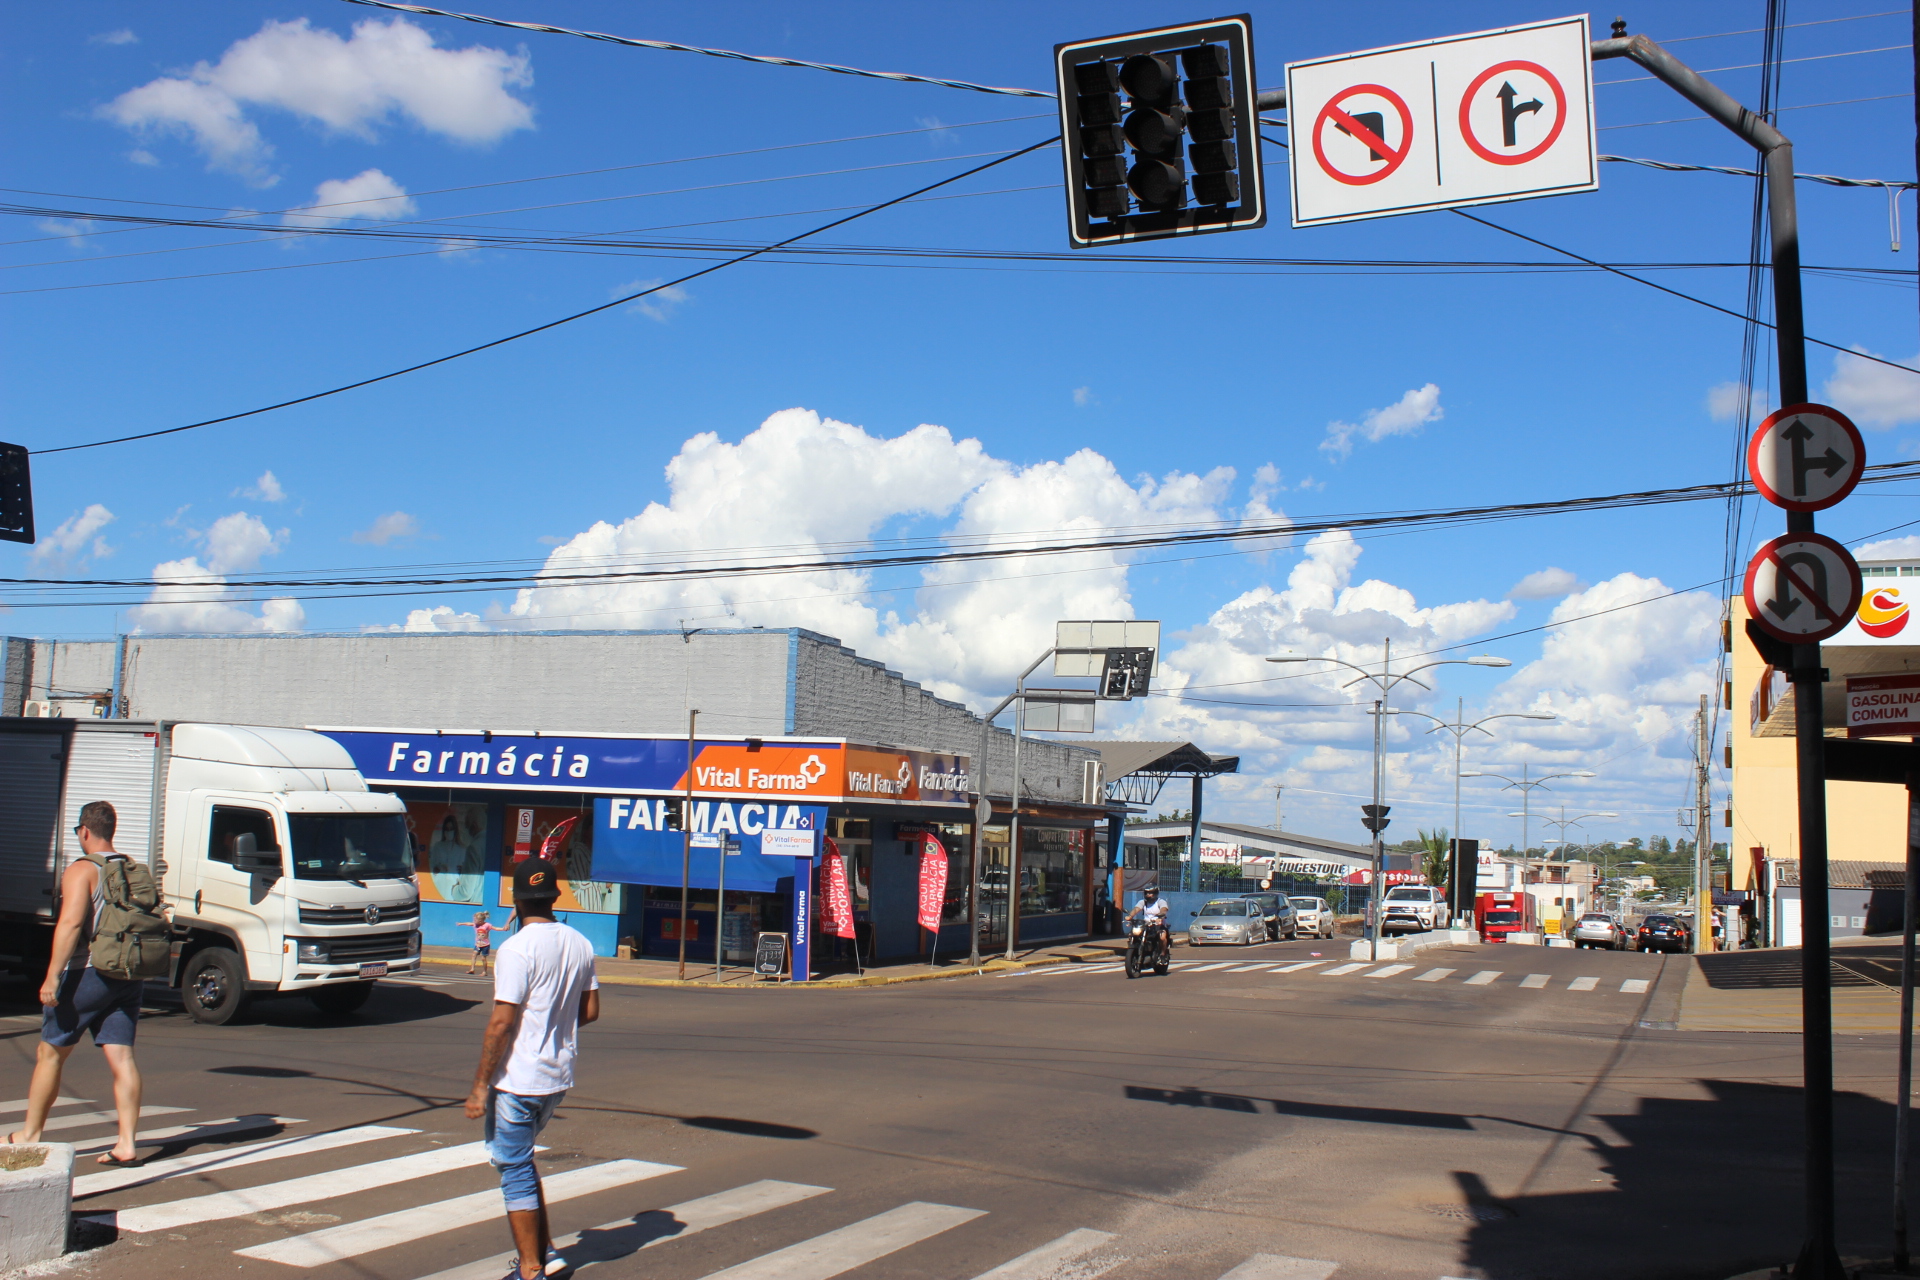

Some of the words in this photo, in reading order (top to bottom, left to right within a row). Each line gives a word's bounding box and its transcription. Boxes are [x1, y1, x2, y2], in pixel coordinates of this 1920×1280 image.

[1851, 692, 1920, 708] GASOLINA
[1852, 707, 1908, 722] COMUM
[388, 742, 590, 778] Farmácia
[696, 766, 741, 788] Vital
[748, 768, 807, 790] Farma
[849, 771, 872, 792] Vital
[874, 773, 902, 794] Farma
[919, 765, 968, 792] Farmácia
[832, 858, 849, 916] POPULAR
[920, 884, 928, 911] AQUI
[928, 859, 938, 913] FARMÁCIA
